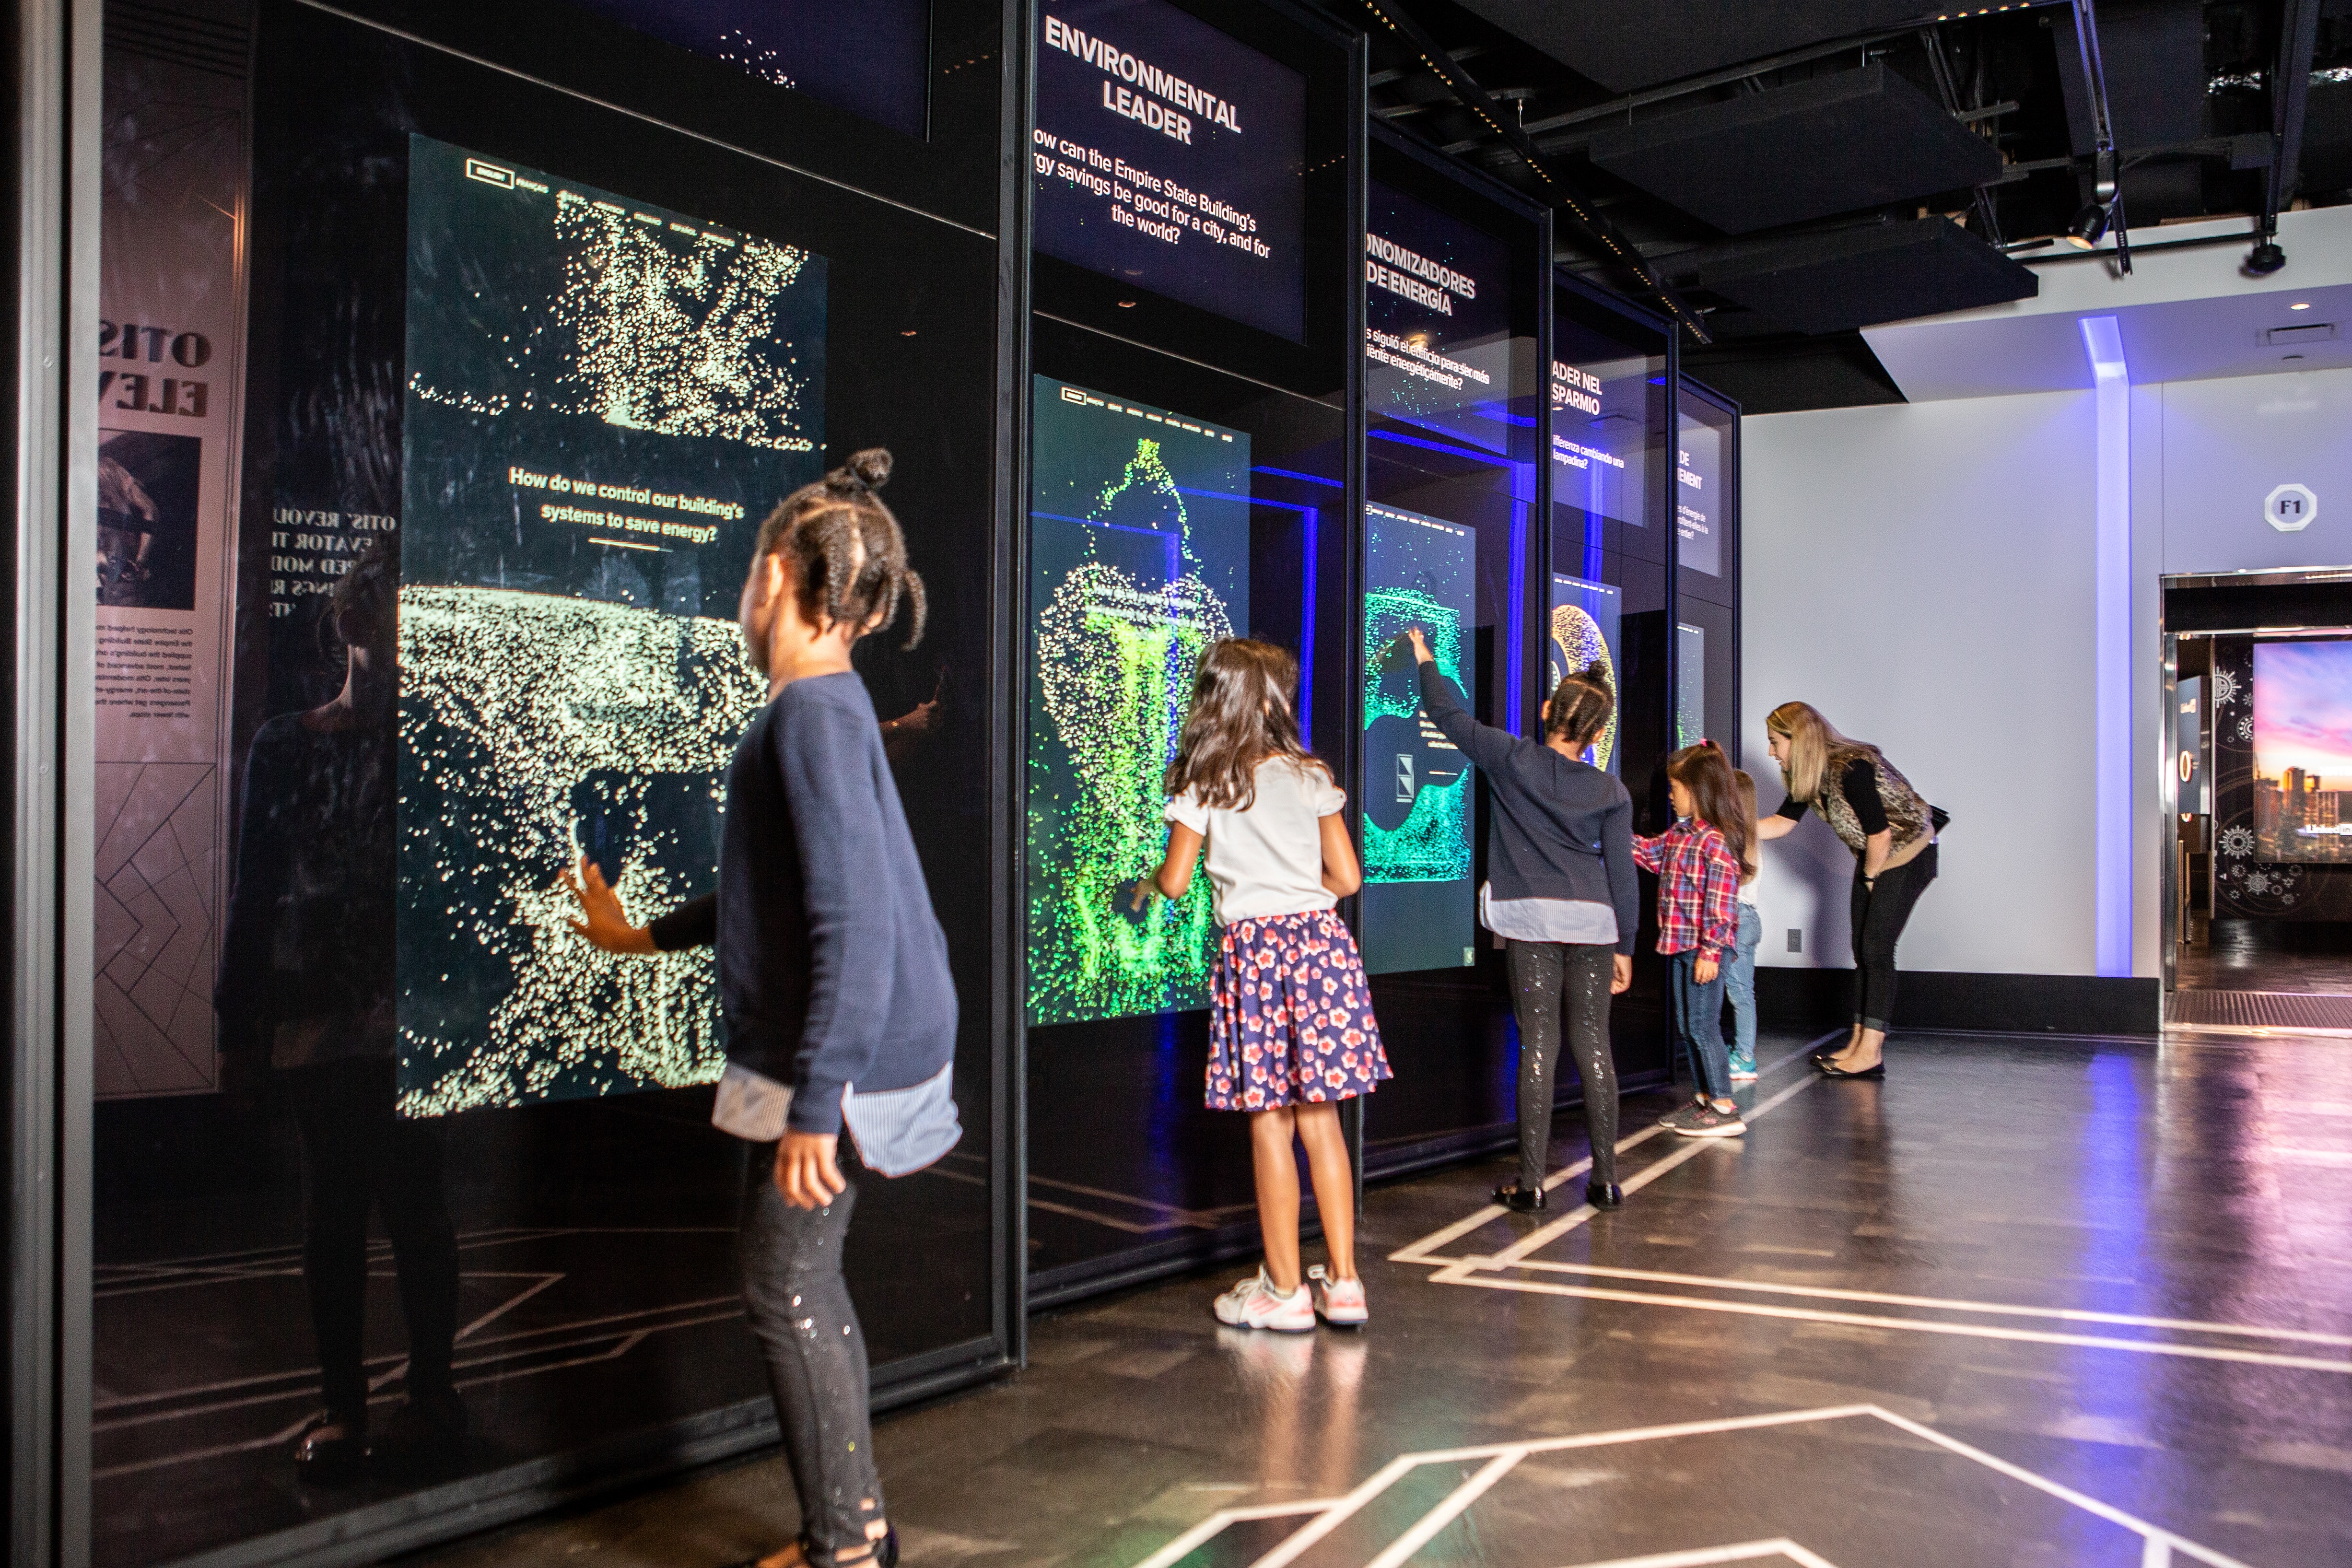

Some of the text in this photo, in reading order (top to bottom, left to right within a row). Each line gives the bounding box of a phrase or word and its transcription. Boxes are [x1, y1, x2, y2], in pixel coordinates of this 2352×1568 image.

[1046, 15, 1241, 133] ENVIRONMENTAL
[1104, 81, 1192, 145] LEADER
[1033, 152, 1271, 258] gy savings be good for a city, and for
[1059, 140, 1086, 162] can
[1088, 148, 1112, 172] the
[1115, 158, 1161, 192] Empire
[1164, 179, 1197, 207] State
[1200, 193, 1256, 232] Building's
[1111, 204, 1181, 245] the world?
[1367, 260, 1452, 316] DE ENERGÍA
[1553, 361, 1603, 396] ADER NEL
[1552, 383, 1600, 416] SPARMIO
[1553, 448, 1588, 469] lampadina?
[1580, 446, 1613, 464] cambiando
[1613, 457, 1624, 468] una
[1680, 450, 1690, 467] DE
[509, 466, 745, 521] How do we control our building's
[2280, 499, 2301, 514] F1
[540, 503, 718, 544] systems to save energy?
